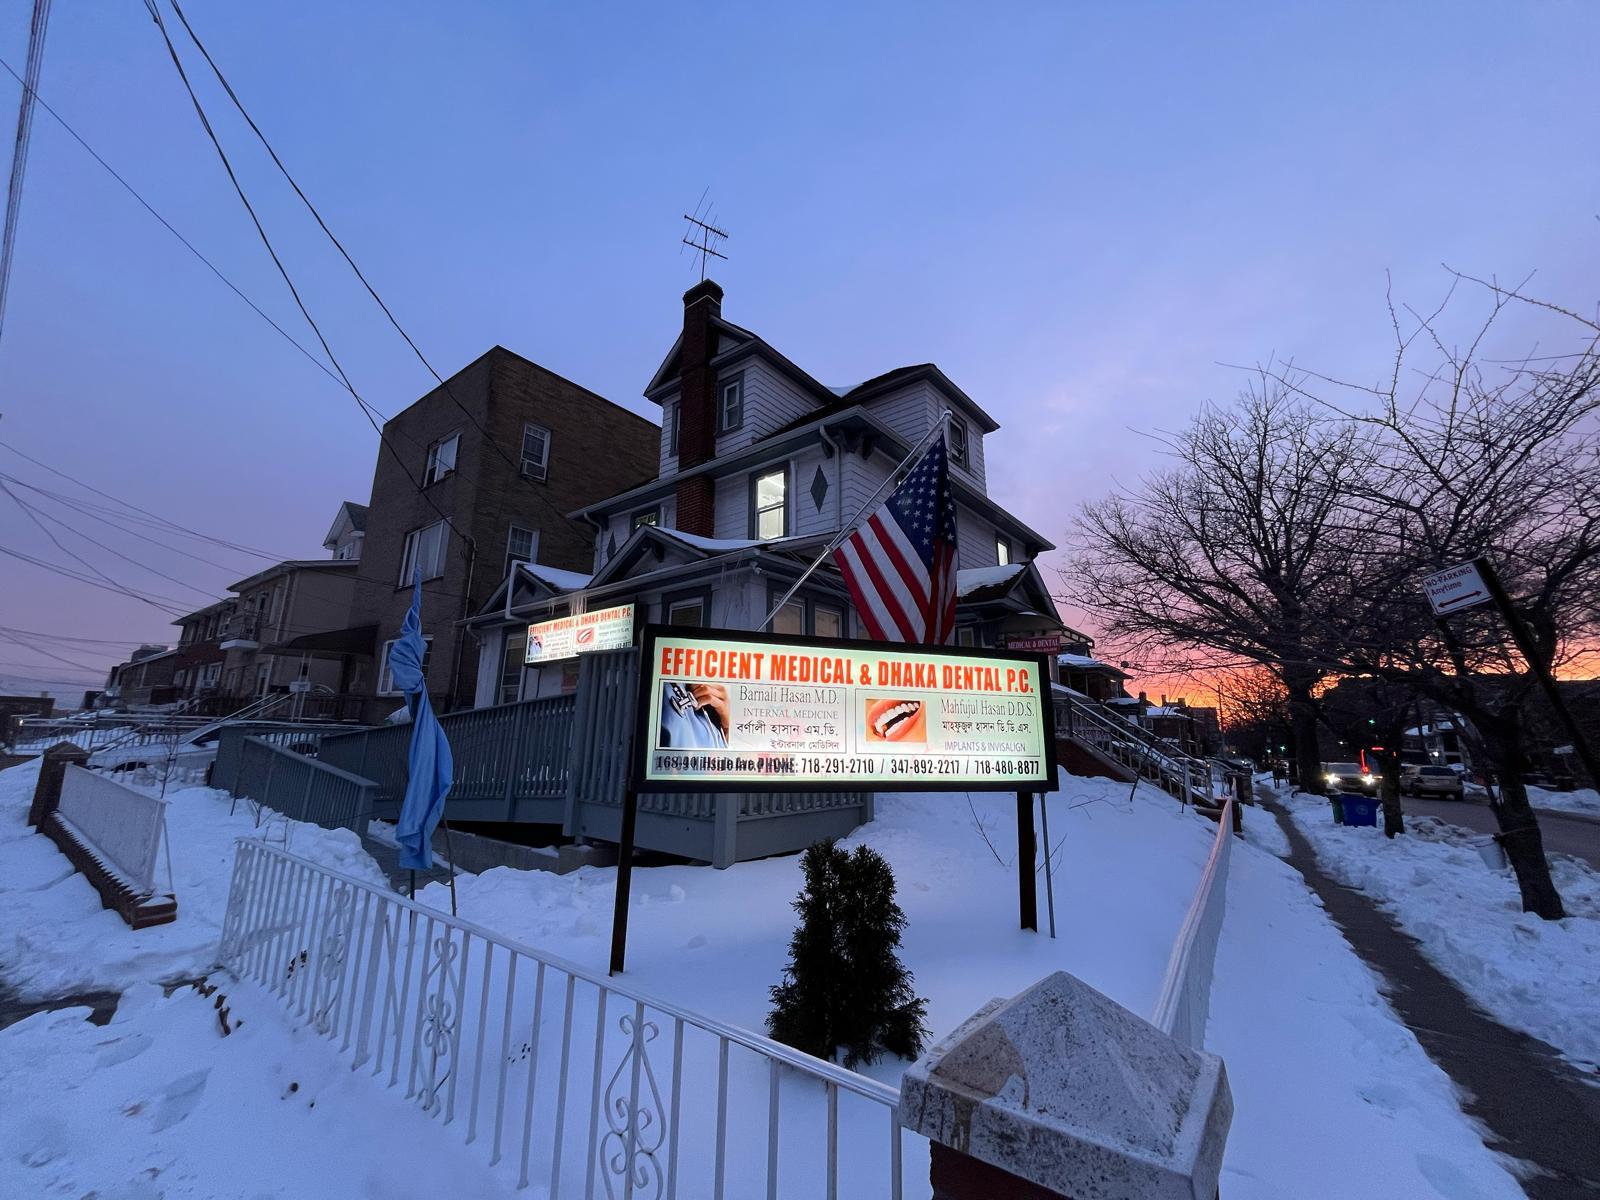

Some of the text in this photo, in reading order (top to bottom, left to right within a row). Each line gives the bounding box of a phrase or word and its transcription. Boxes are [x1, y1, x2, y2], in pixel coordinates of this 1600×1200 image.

[1439, 566, 1473, 583] PARKING
[1431, 581, 1462, 595] Anytime
[1037, 638, 1058, 648] DENTAL
[661, 647, 765, 680] EFFICIENT
[771, 654, 854, 685] MEDICAL
[860, 663, 872, 685] &
[878, 660, 937, 689] DHAKA
[942, 664, 1003, 692] DENTAL
[1006, 667, 1034, 694] P.C.
[740, 685, 840, 705] Barnali Hasan M.D.
[743, 707, 839, 720] INTERNAL MEDICINE
[941, 698, 1035, 719] Mahfujul Hasan D.D.S.
[736, 720, 839, 737] বর্ণালী হাসান এম.ডি.
[942, 720, 973, 734] মাহফুজুল
[975, 722, 995, 733] হাসান
[944, 741, 1026, 753] IMPLANTS & INVISALIGN
[802, 758, 875, 775] 718-291-2710
[891, 759, 960, 775] 347-892-2217
[975, 759, 1040, 775] 718-480-8877
